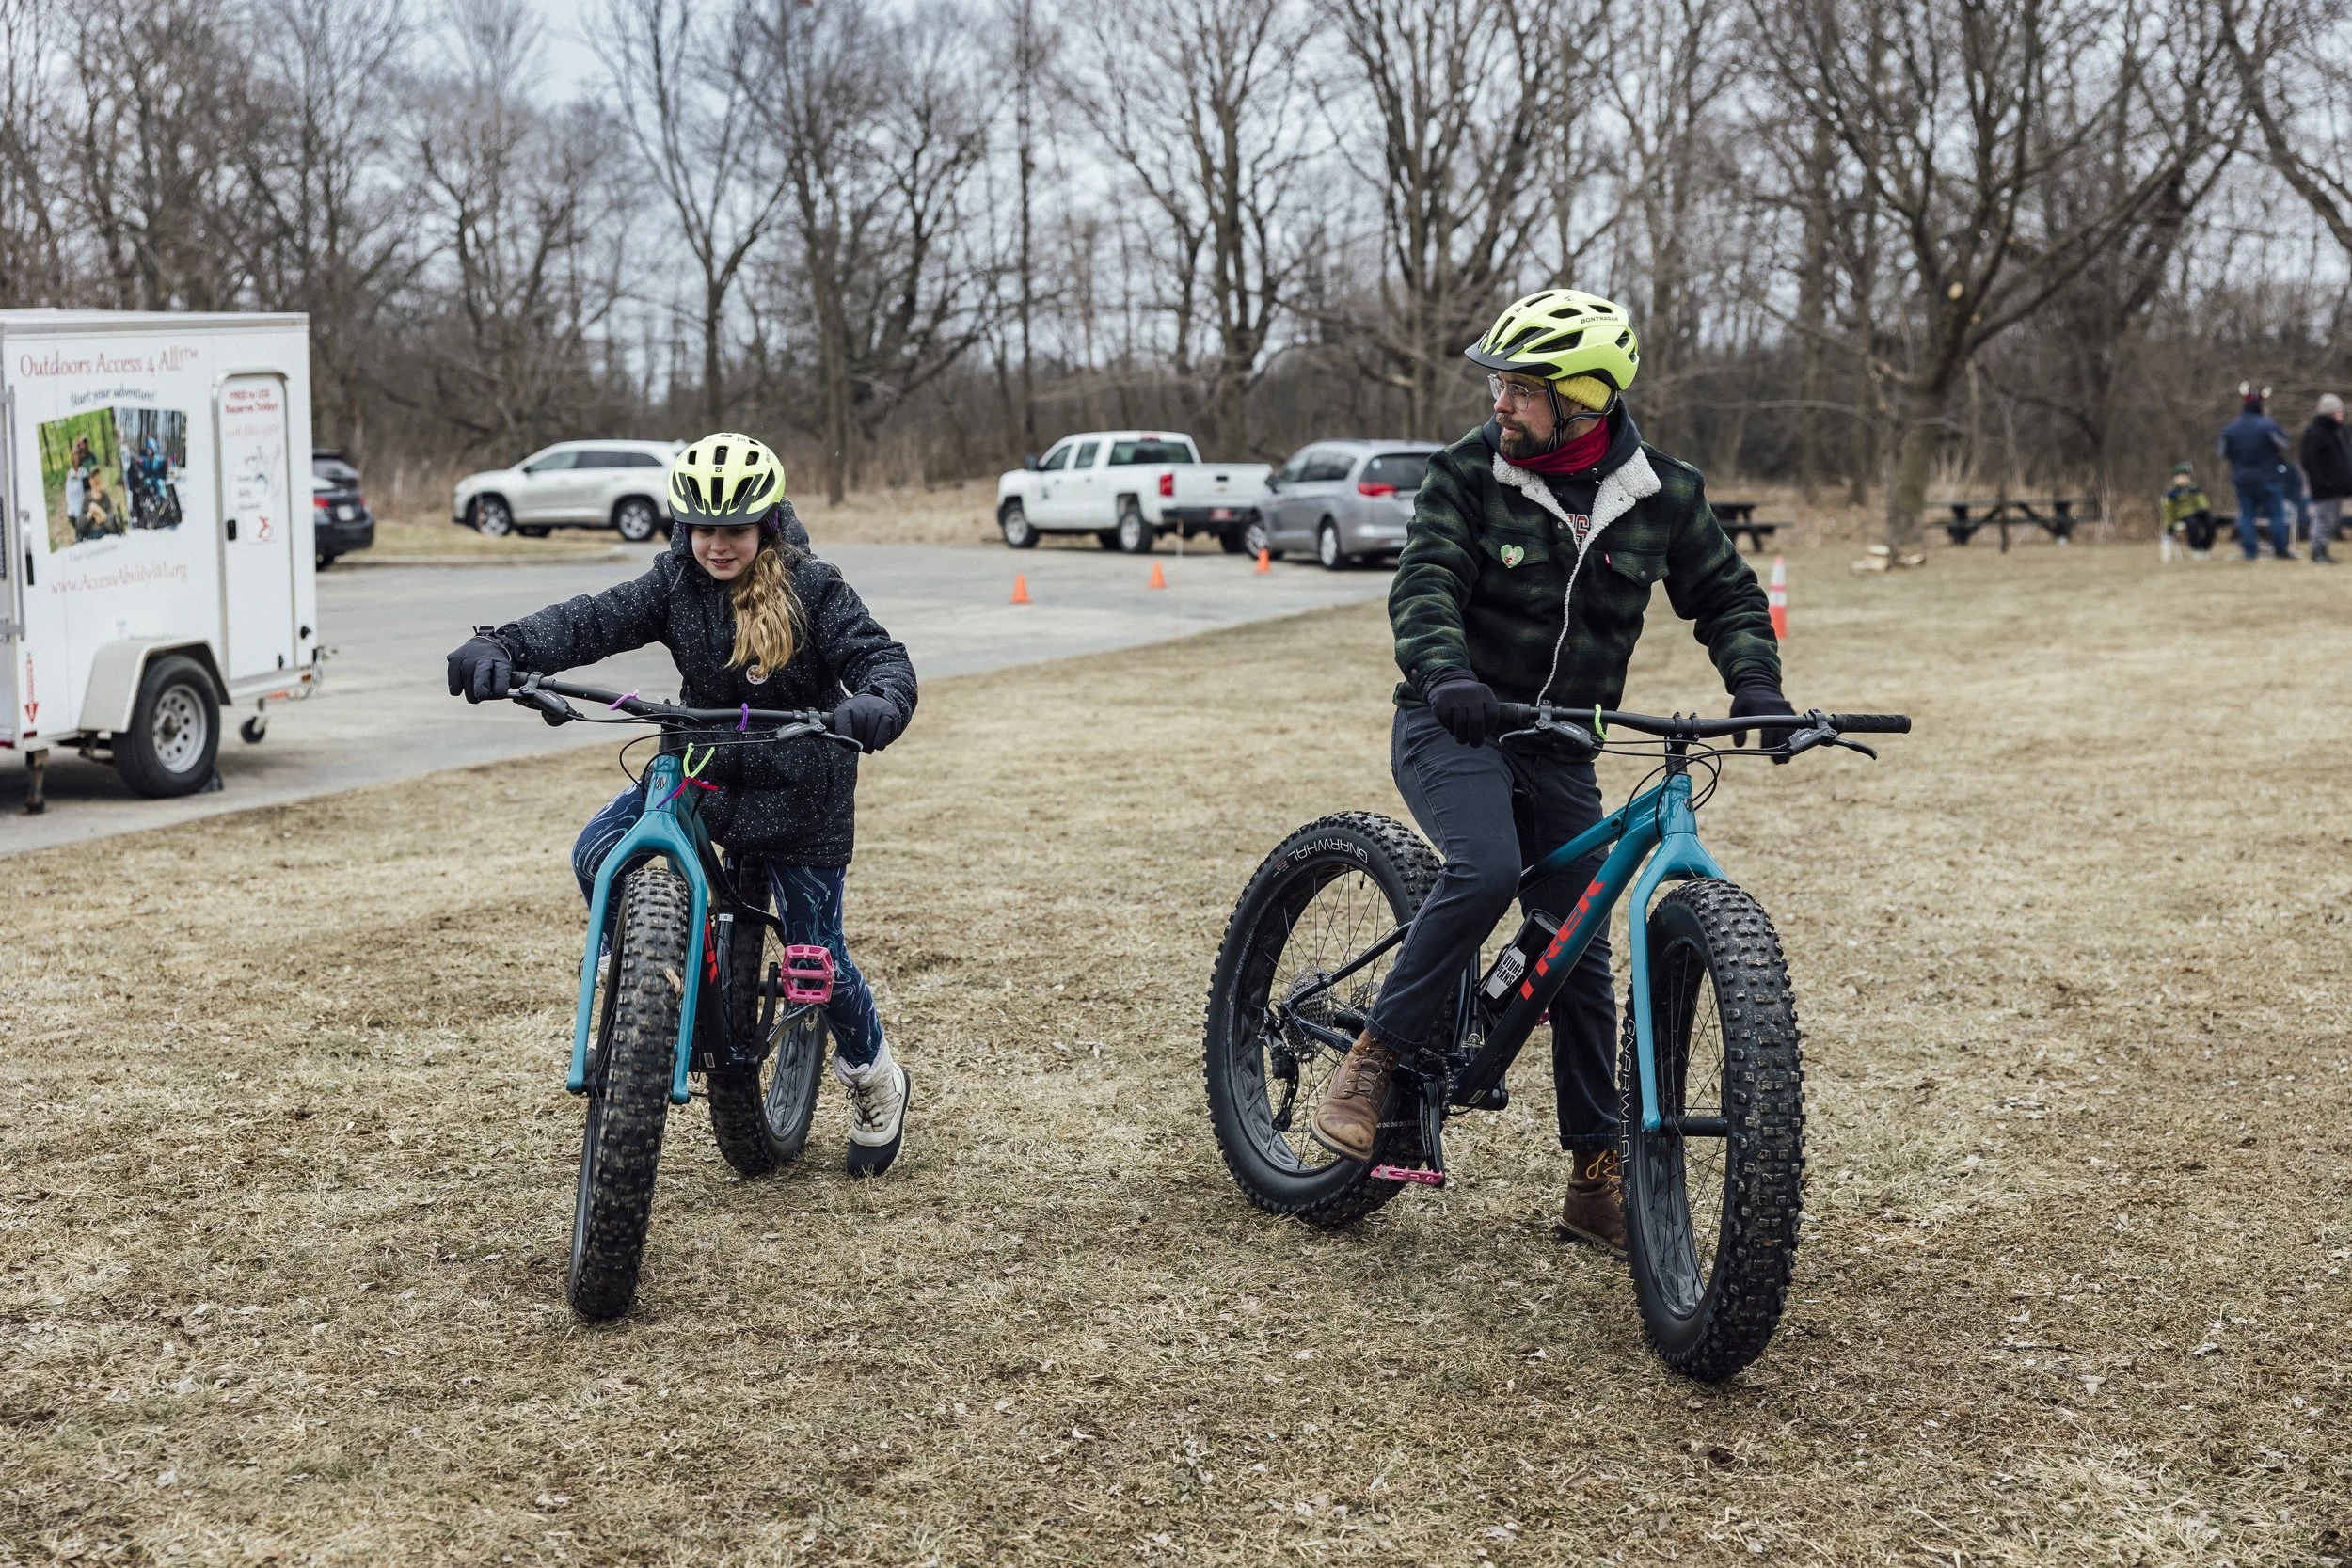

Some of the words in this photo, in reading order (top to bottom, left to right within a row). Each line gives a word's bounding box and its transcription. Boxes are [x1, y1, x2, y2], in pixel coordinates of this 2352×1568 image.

[20, 351, 91, 376] Outdoors
[95, 352, 142, 374] Access
[1287, 838, 1368, 863] GNARWHAL
[1621, 1019, 1636, 1176] GNARWHAL
